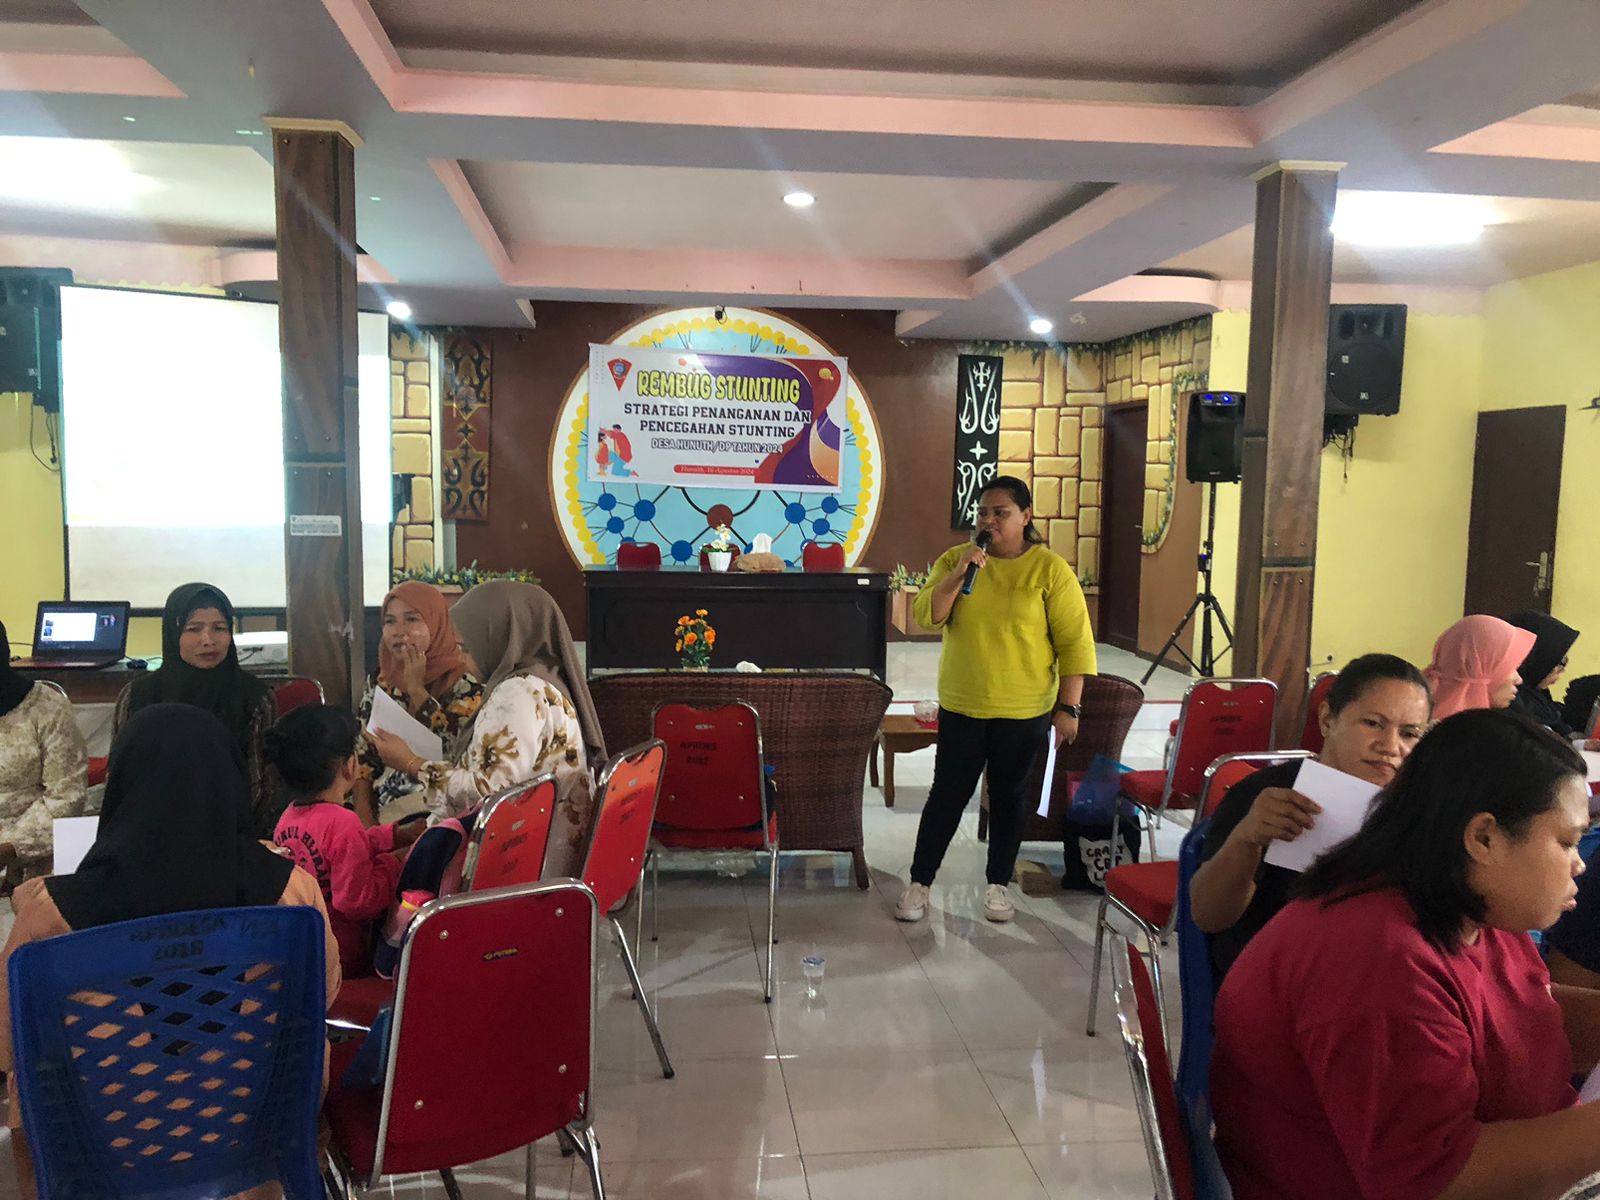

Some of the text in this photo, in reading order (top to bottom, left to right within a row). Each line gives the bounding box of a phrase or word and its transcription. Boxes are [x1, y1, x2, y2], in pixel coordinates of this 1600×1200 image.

[637, 370, 801, 404] REMBUG STUNTING
[624, 403, 811, 423] STRATEGI PENANGANAN DAN
[640, 420, 795, 438] PENCEGAHAN STUNTING
[651, 438, 675, 449] DESA
[732, 441, 762, 453] TAHUN
[762, 443, 785, 455] 2024
[1086, 845, 1123, 858] CRAY
